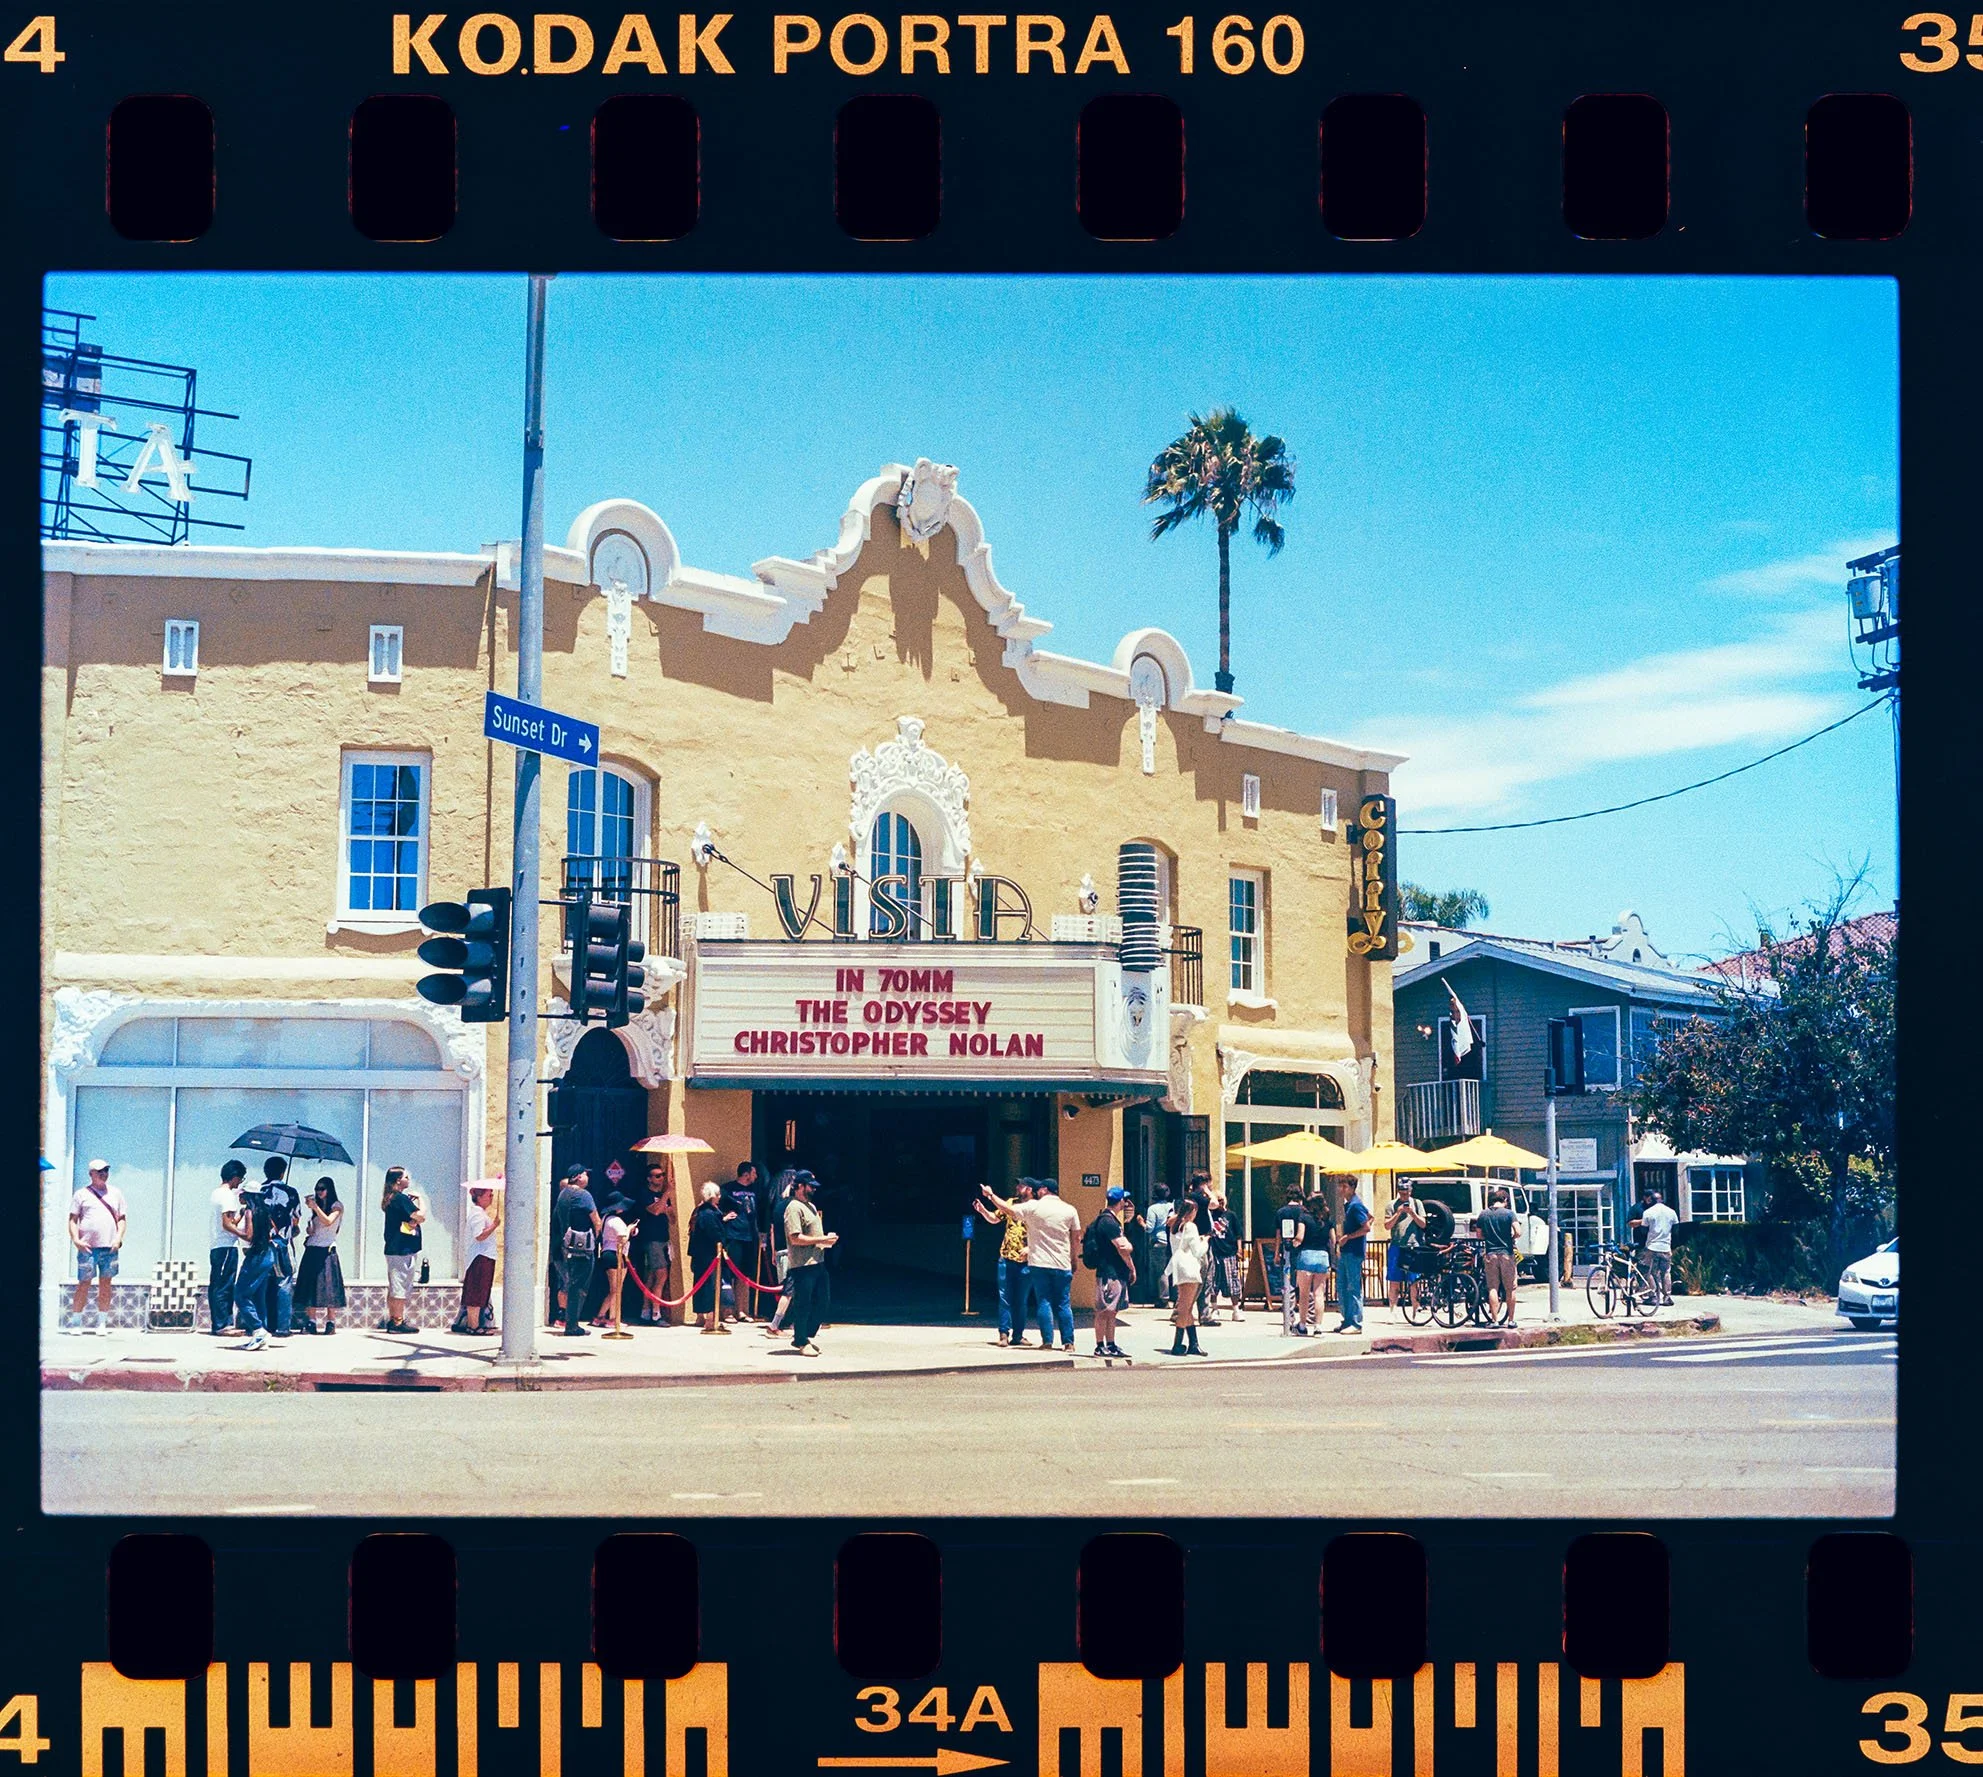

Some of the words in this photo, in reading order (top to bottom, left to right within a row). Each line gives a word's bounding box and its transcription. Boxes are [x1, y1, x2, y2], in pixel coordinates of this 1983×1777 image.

[4, 15, 66, 74] 4
[773, 13, 1131, 75] PORTRA
[1166, 14, 1305, 75] 160
[492, 704, 545, 742] Sunset
[551, 722, 568, 748] Dr
[770, 873, 1032, 941] VISTA
[836, 969, 864, 993] IN
[879, 969, 953, 993] 70MM
[796, 999, 847, 1024] THE
[863, 1000, 992, 1026] ODYSSEY
[734, 1031, 928, 1056] CHRISTOPHER
[949, 1032, 1043, 1057] NOLAN
[1083, 1175, 1100, 1185] 4473
[0, 1695, 51, 1764] 4
[854, 1685, 1014, 1733] 34A
